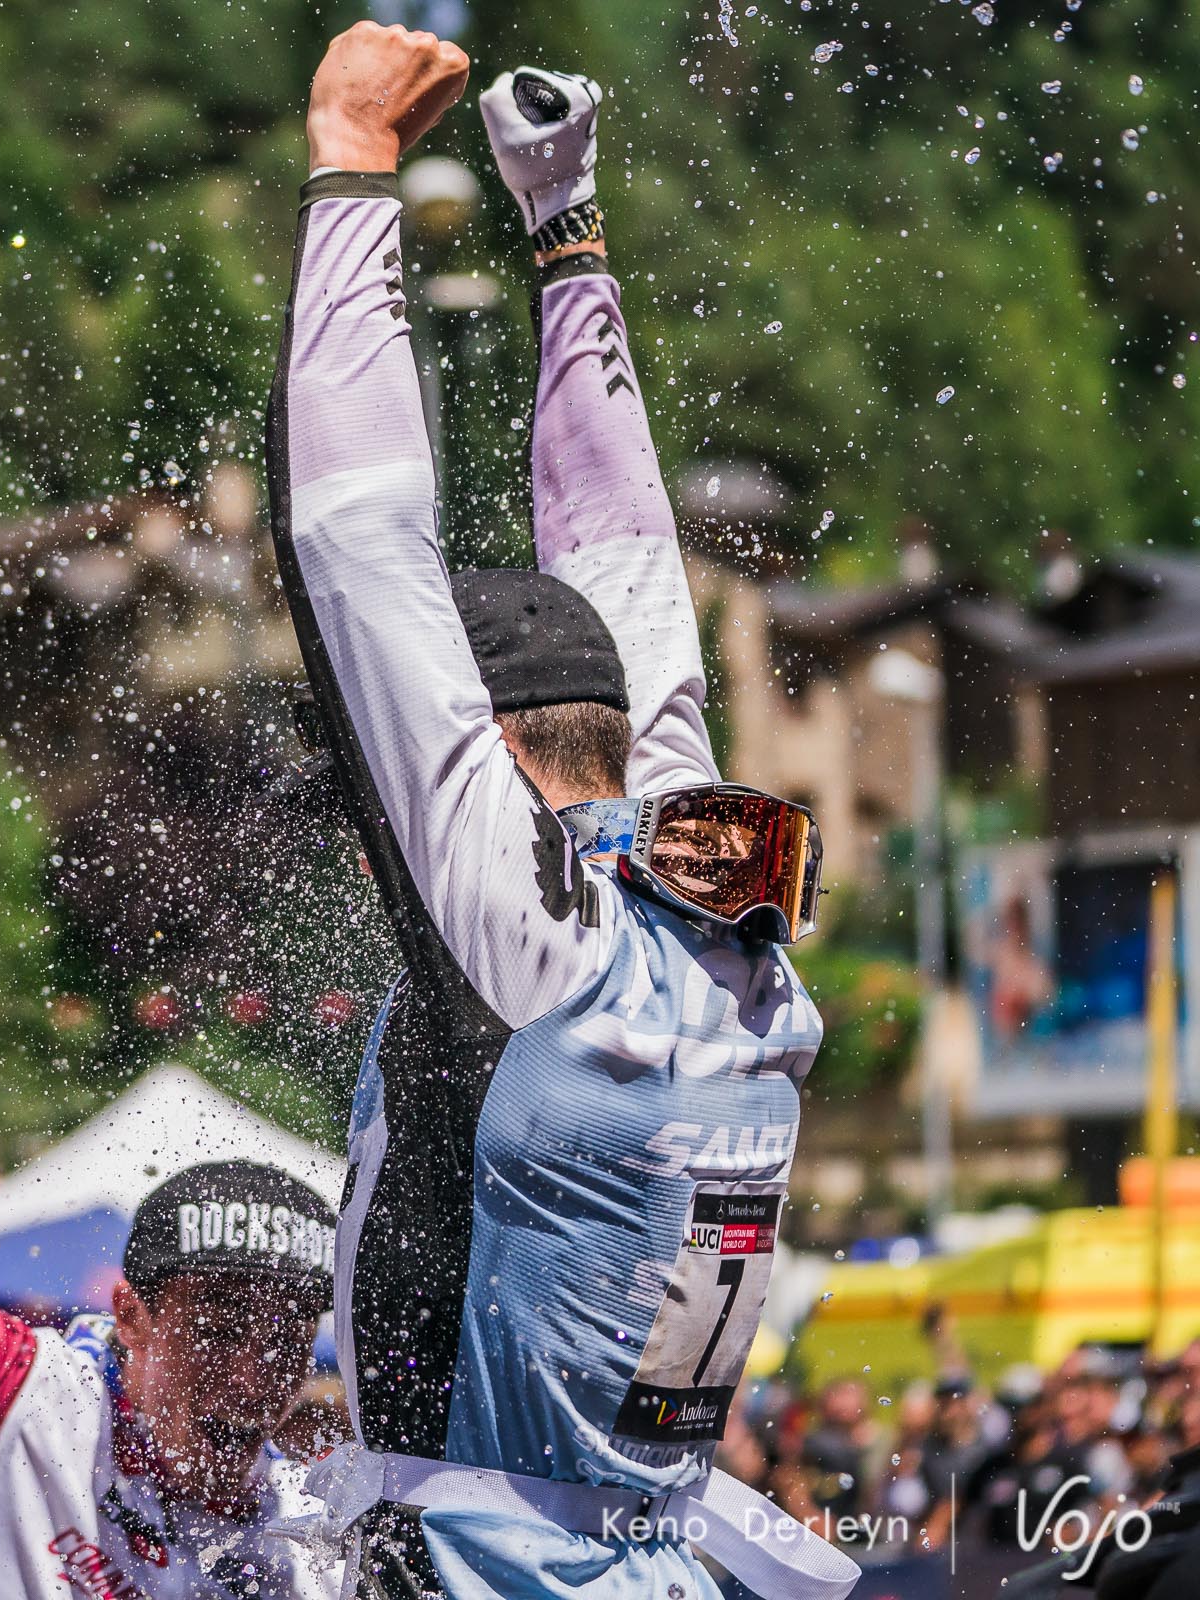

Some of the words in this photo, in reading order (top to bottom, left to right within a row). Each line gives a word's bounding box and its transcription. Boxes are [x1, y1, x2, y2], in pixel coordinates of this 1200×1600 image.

[635, 800, 654, 856] OAKLEY
[728, 1203, 766, 1216] Mercedes-Benz
[697, 1228, 721, 1249] UCI
[724, 1229, 746, 1238] MOUNTAIN
[746, 1229, 756, 1238] BIKE
[722, 1240, 737, 1249] WORLD
[738, 1240, 746, 1249] CUP
[691, 1258, 746, 1388] 7
[676, 1398, 719, 1422] Andorra
